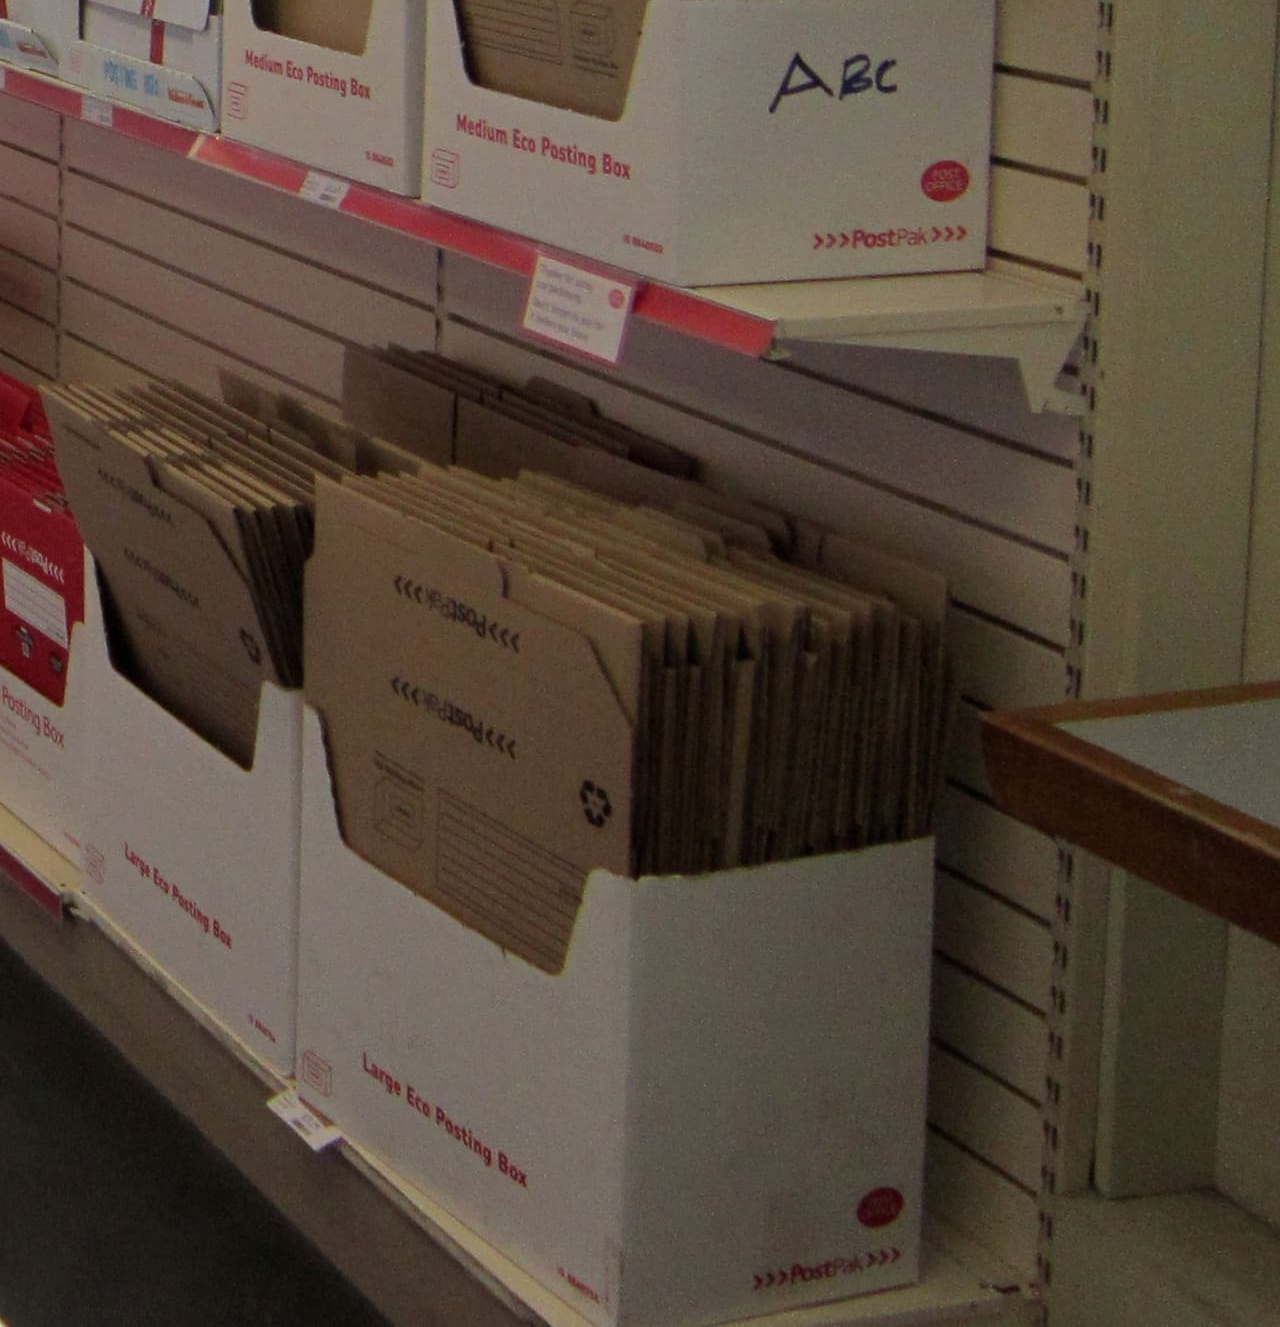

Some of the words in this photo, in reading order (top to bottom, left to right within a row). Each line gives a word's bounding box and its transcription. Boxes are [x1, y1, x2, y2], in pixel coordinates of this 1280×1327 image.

[244, 50, 283, 77] Medium
[285, 60, 304, 82] Eco
[306, 66, 348, 97] Posting
[349, 78, 371, 100] Box
[768, 51, 899, 114] ABC
[456, 113, 508, 146] Medium
[511, 129, 537, 154] Eco
[541, 136, 597, 174] Posting
[602, 153, 631, 180] Box
[851, 226, 928, 250] PostPak
[425, 589, 487, 640] PostPak
[0, 678, 42, 735] Posting
[41, 712, 66, 747] Box
[422, 691, 484, 743] PostPak
[123, 842, 151, 881] Large
[151, 863, 171, 894] Eco
[171, 882, 211, 934] Posting
[212, 917, 233, 949] Box
[361, 1051, 402, 1096] Large
[405, 1085, 431, 1116] Eco
[435, 1105, 493, 1166] Posting
[497, 1150, 528, 1188] Box
[790, 1255, 864, 1283] PostPak
